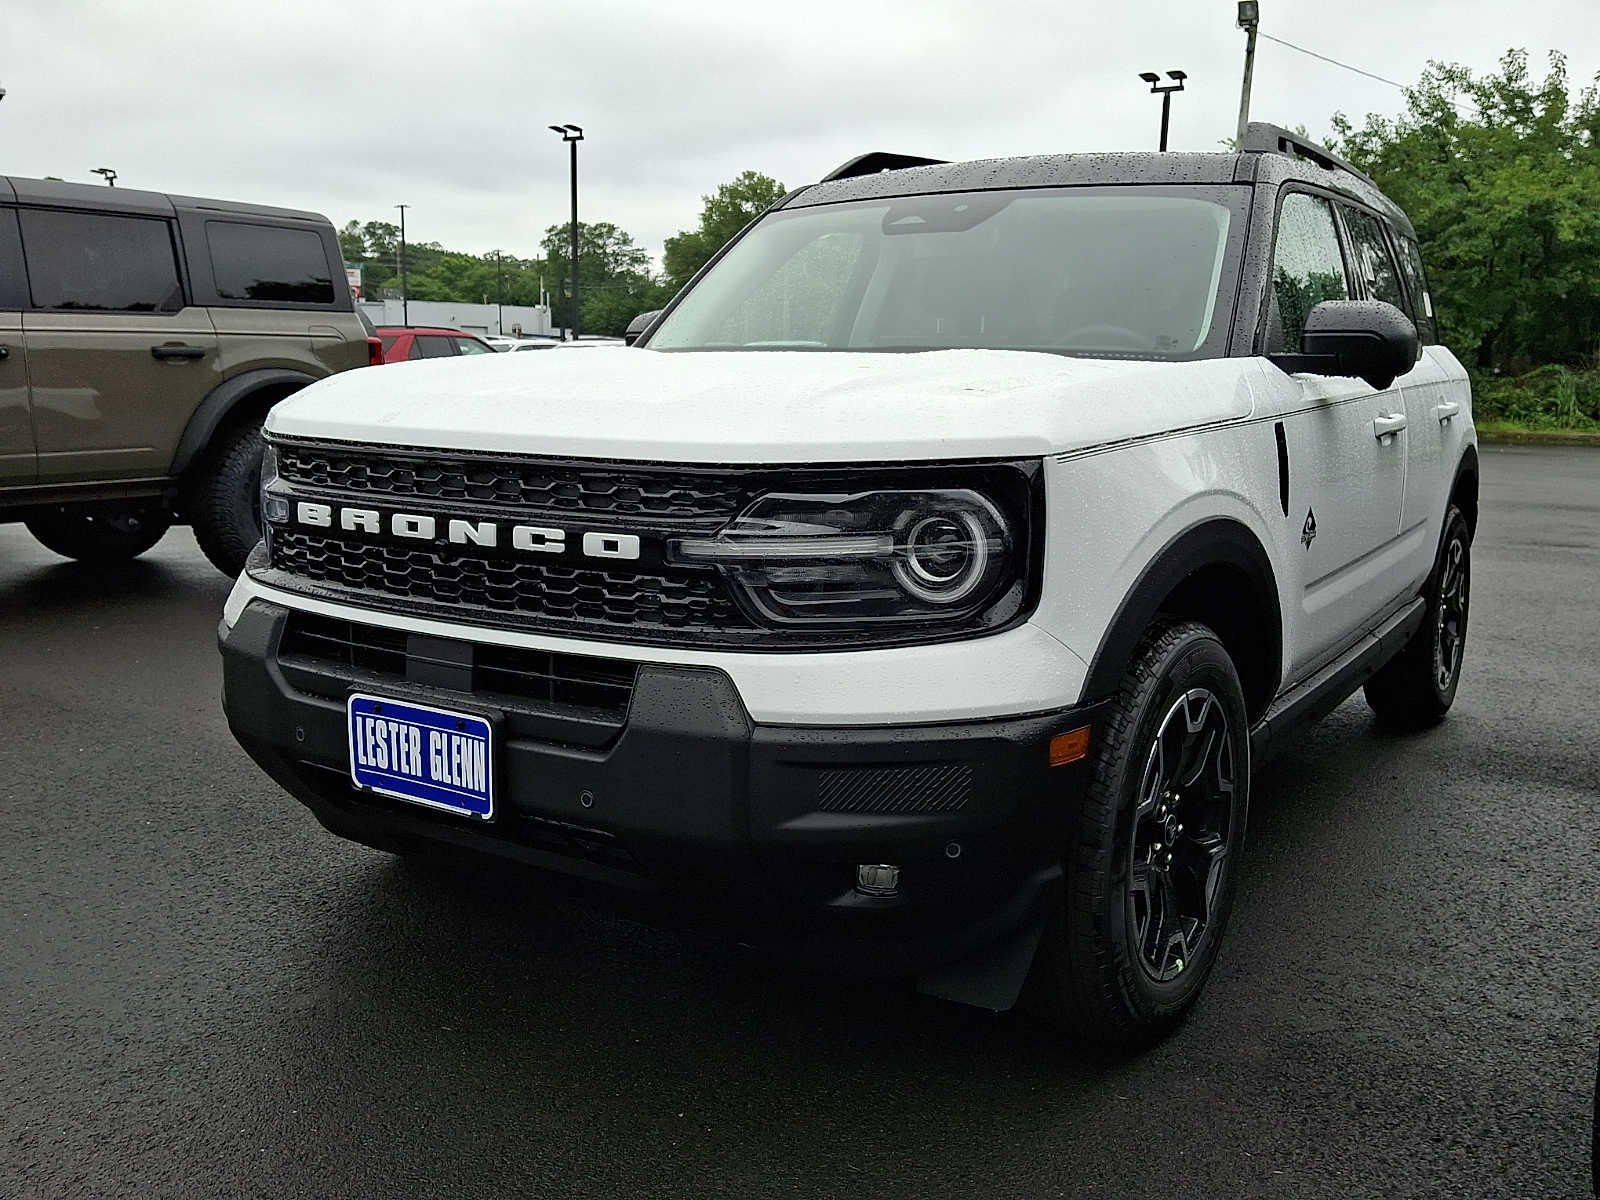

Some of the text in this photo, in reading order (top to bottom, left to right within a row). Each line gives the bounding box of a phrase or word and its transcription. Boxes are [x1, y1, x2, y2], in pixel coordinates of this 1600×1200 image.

[297, 501, 640, 560] BRONCO
[356, 716, 486, 793] LESTER GLENN
